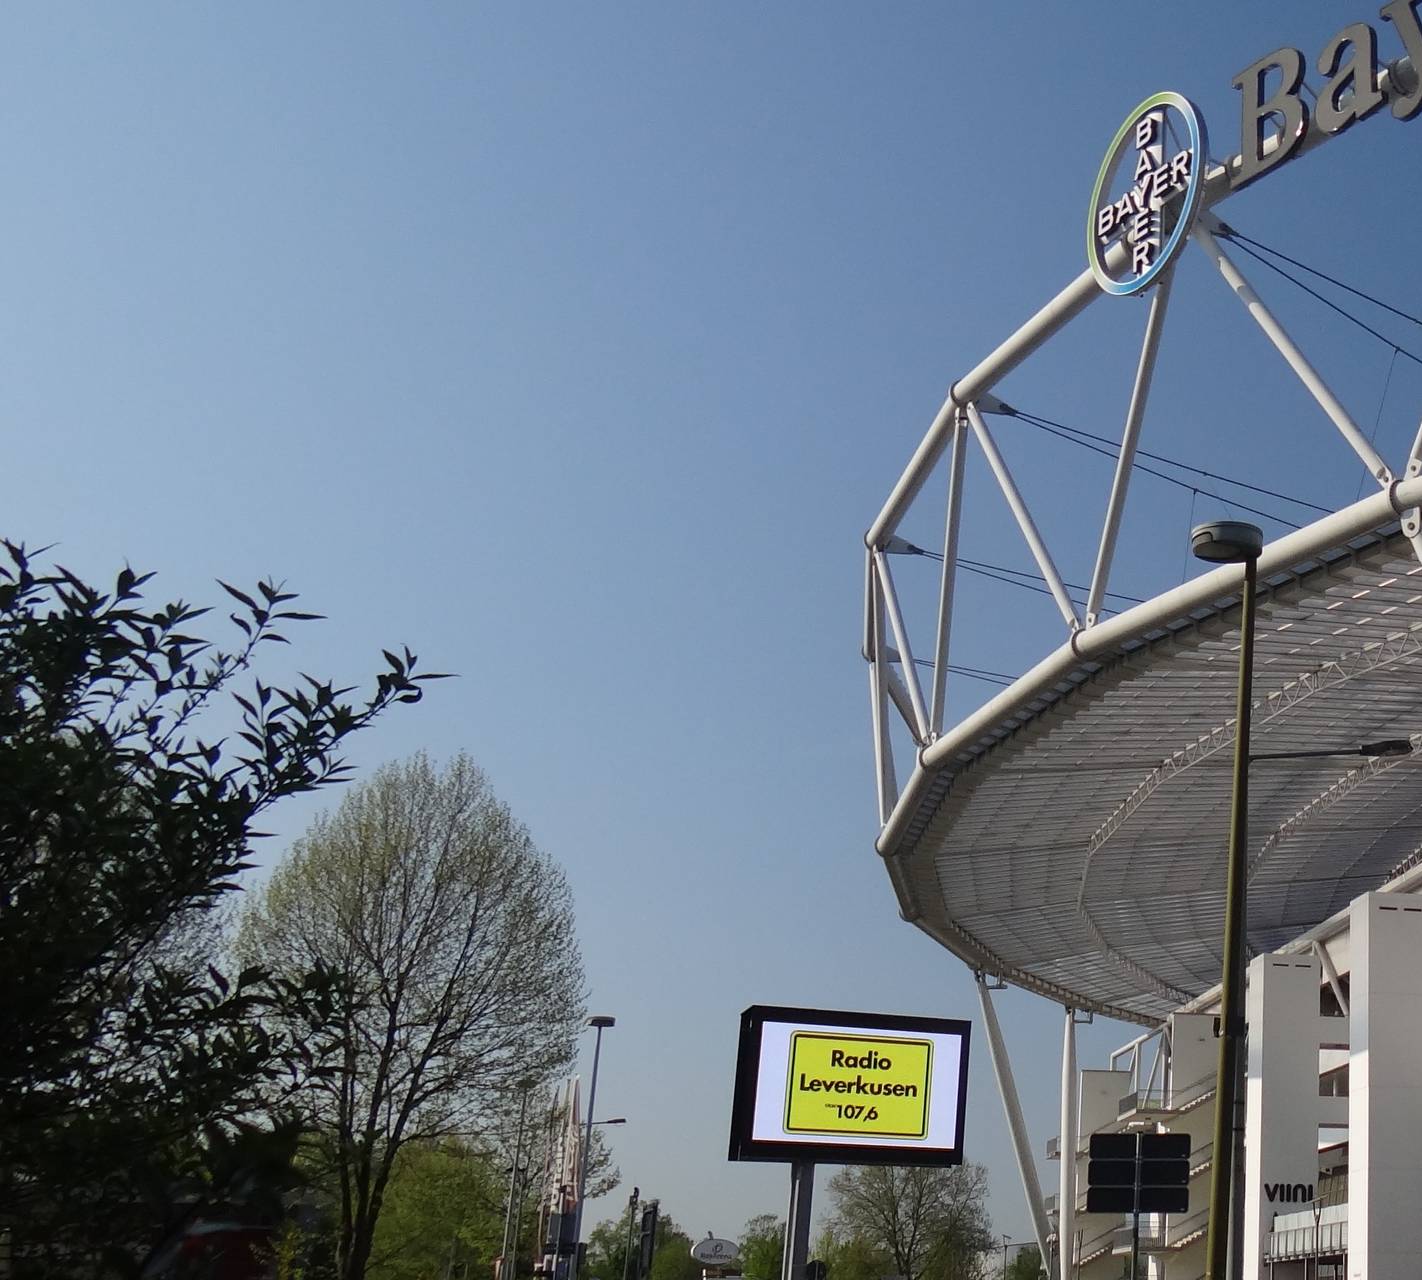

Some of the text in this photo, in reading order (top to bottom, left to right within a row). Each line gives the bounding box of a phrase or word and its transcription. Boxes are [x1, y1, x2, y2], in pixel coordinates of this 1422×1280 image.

[1098, 149, 1189, 236] BAYER
[1134, 117, 1153, 274] BAYER
[831, 1049, 892, 1070] Radio
[799, 1073, 918, 1097] Leverkusen
[837, 1104, 878, 1122] 107,6
